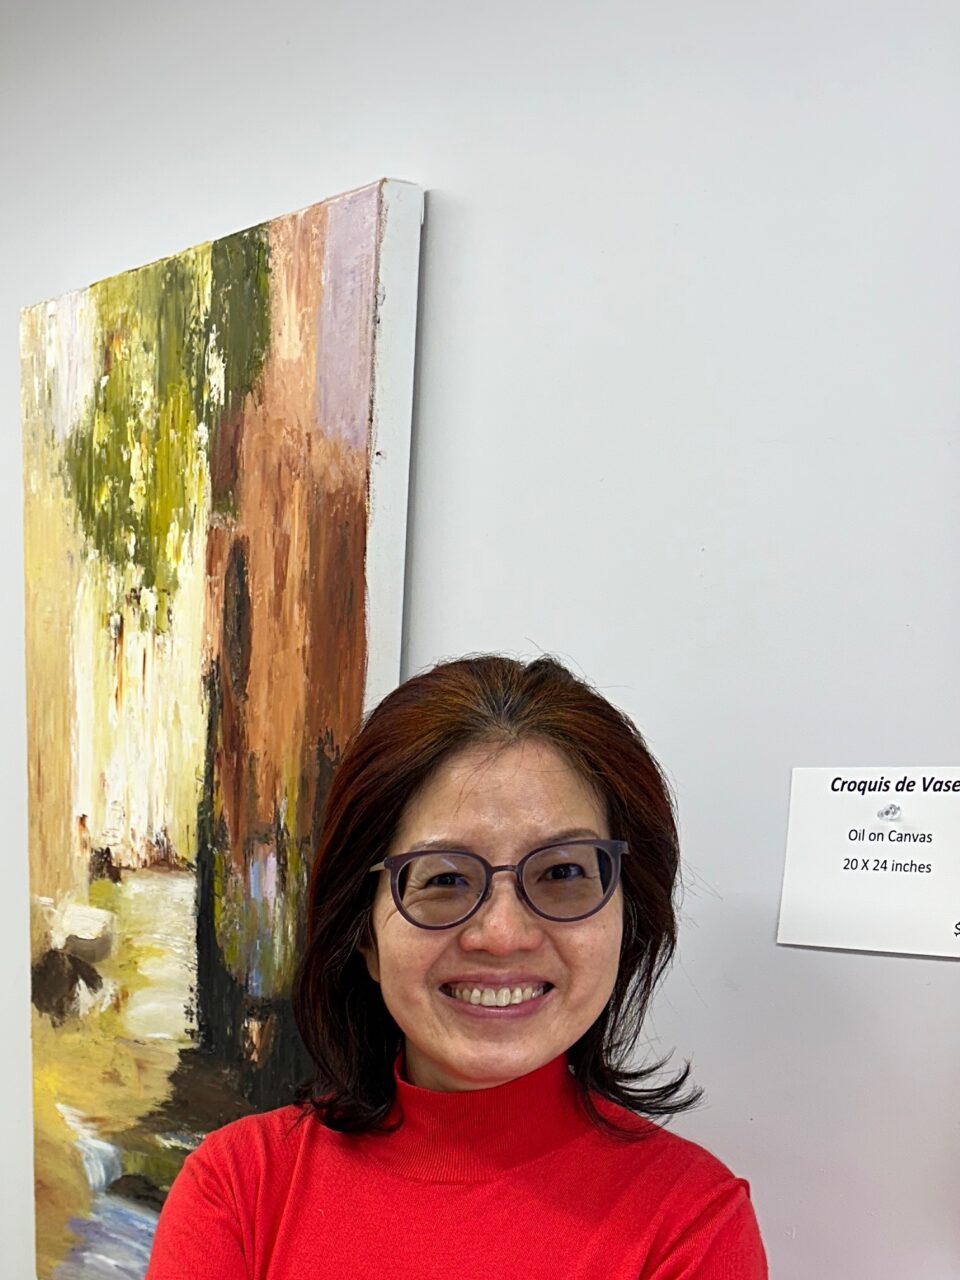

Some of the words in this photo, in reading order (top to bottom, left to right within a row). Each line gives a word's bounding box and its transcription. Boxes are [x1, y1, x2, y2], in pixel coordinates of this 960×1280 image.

[830, 776, 891, 796] Croquis
[895, 776, 916, 792] de
[921, 776, 960, 793] Vase
[848, 828, 865, 842] Oil
[868, 831, 884, 842] on
[888, 829, 933, 844] Canvas
[842, 858, 859, 871] 20
[860, 858, 870, 871] X
[872, 858, 888, 872] 24
[891, 859, 932, 874] inches
